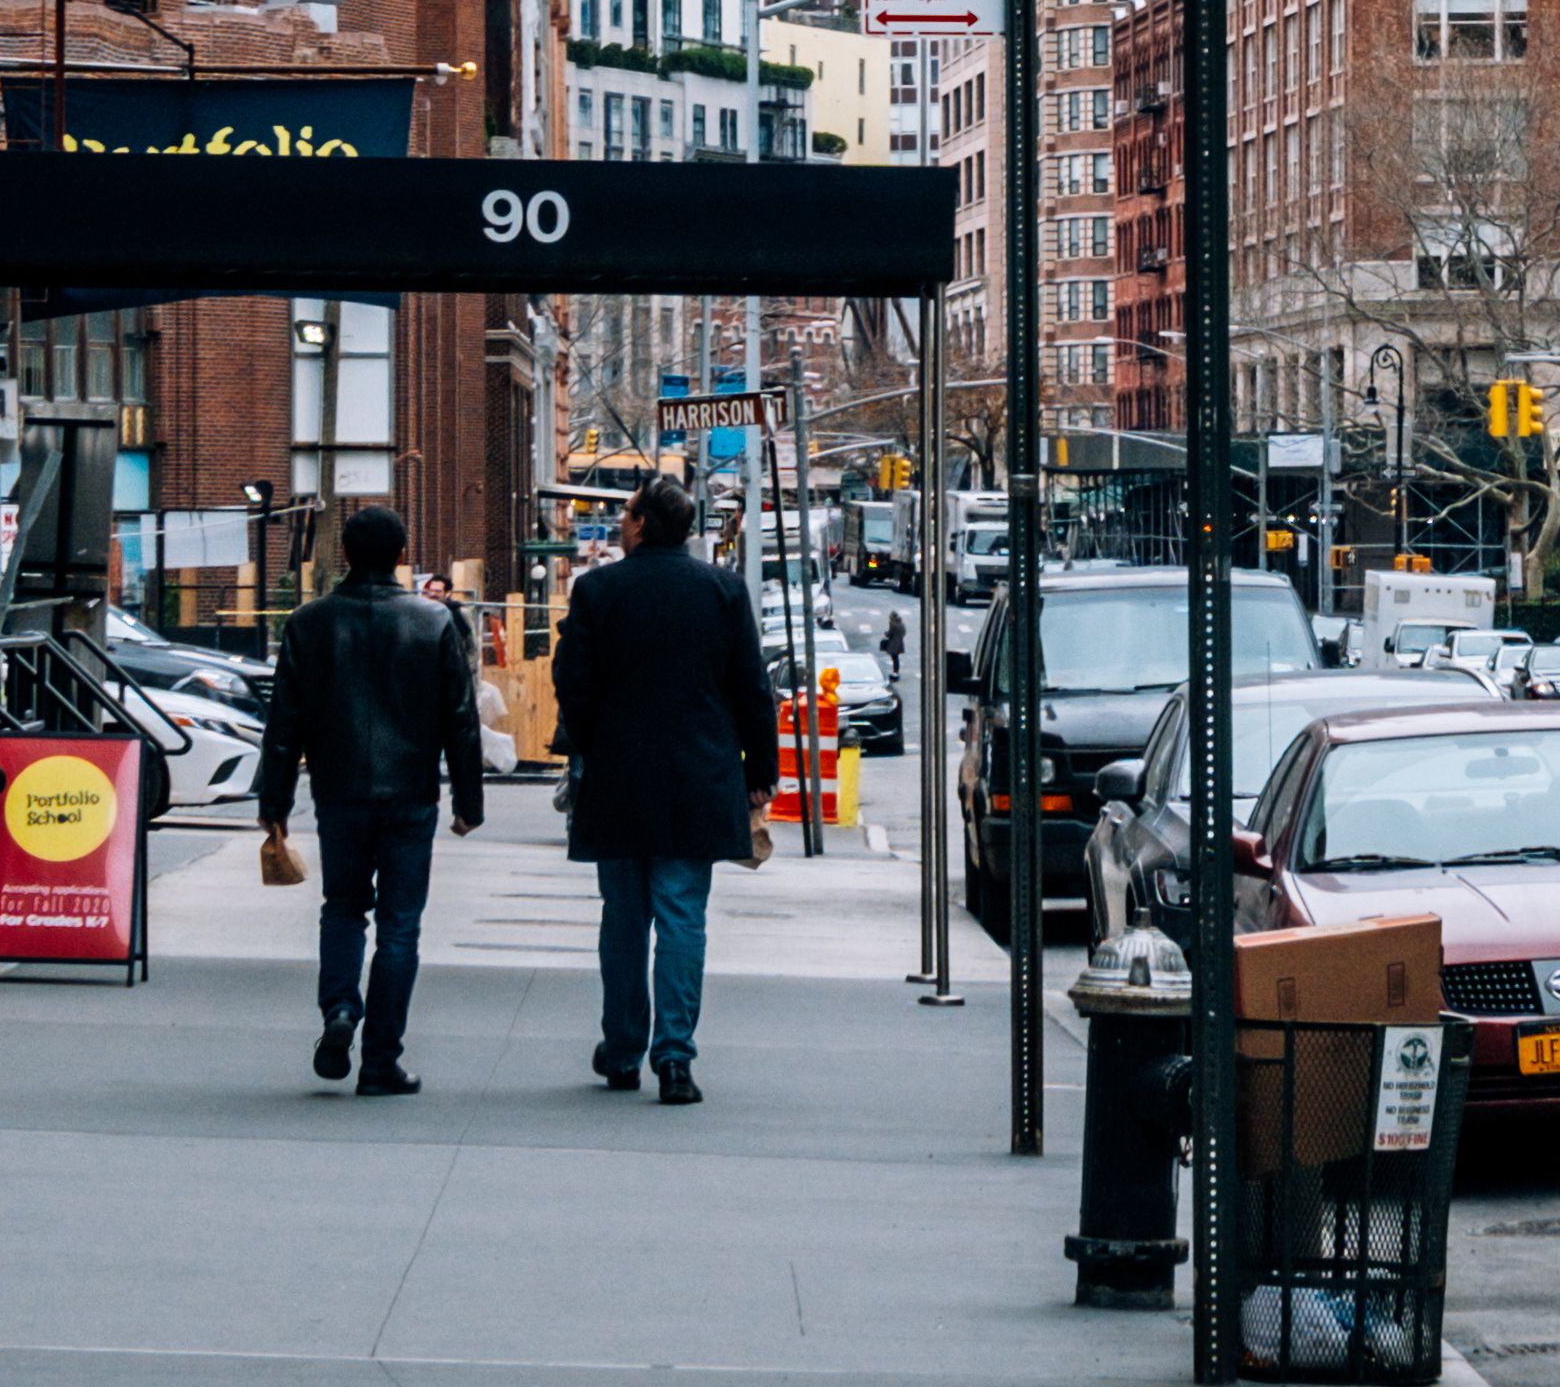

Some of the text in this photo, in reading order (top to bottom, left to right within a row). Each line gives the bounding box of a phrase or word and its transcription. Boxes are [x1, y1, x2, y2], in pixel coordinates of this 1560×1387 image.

[481, 189, 571, 244] 90
[663, 399, 755, 430] HARRISON
[26, 790, 100, 808] Portfolio
[26, 809, 81, 826] School
[1, 884, 50, 896] Accepting
[1, 894, 23, 912] for
[73, 896, 110, 913] 2020
[25, 913, 83, 927] Grades
